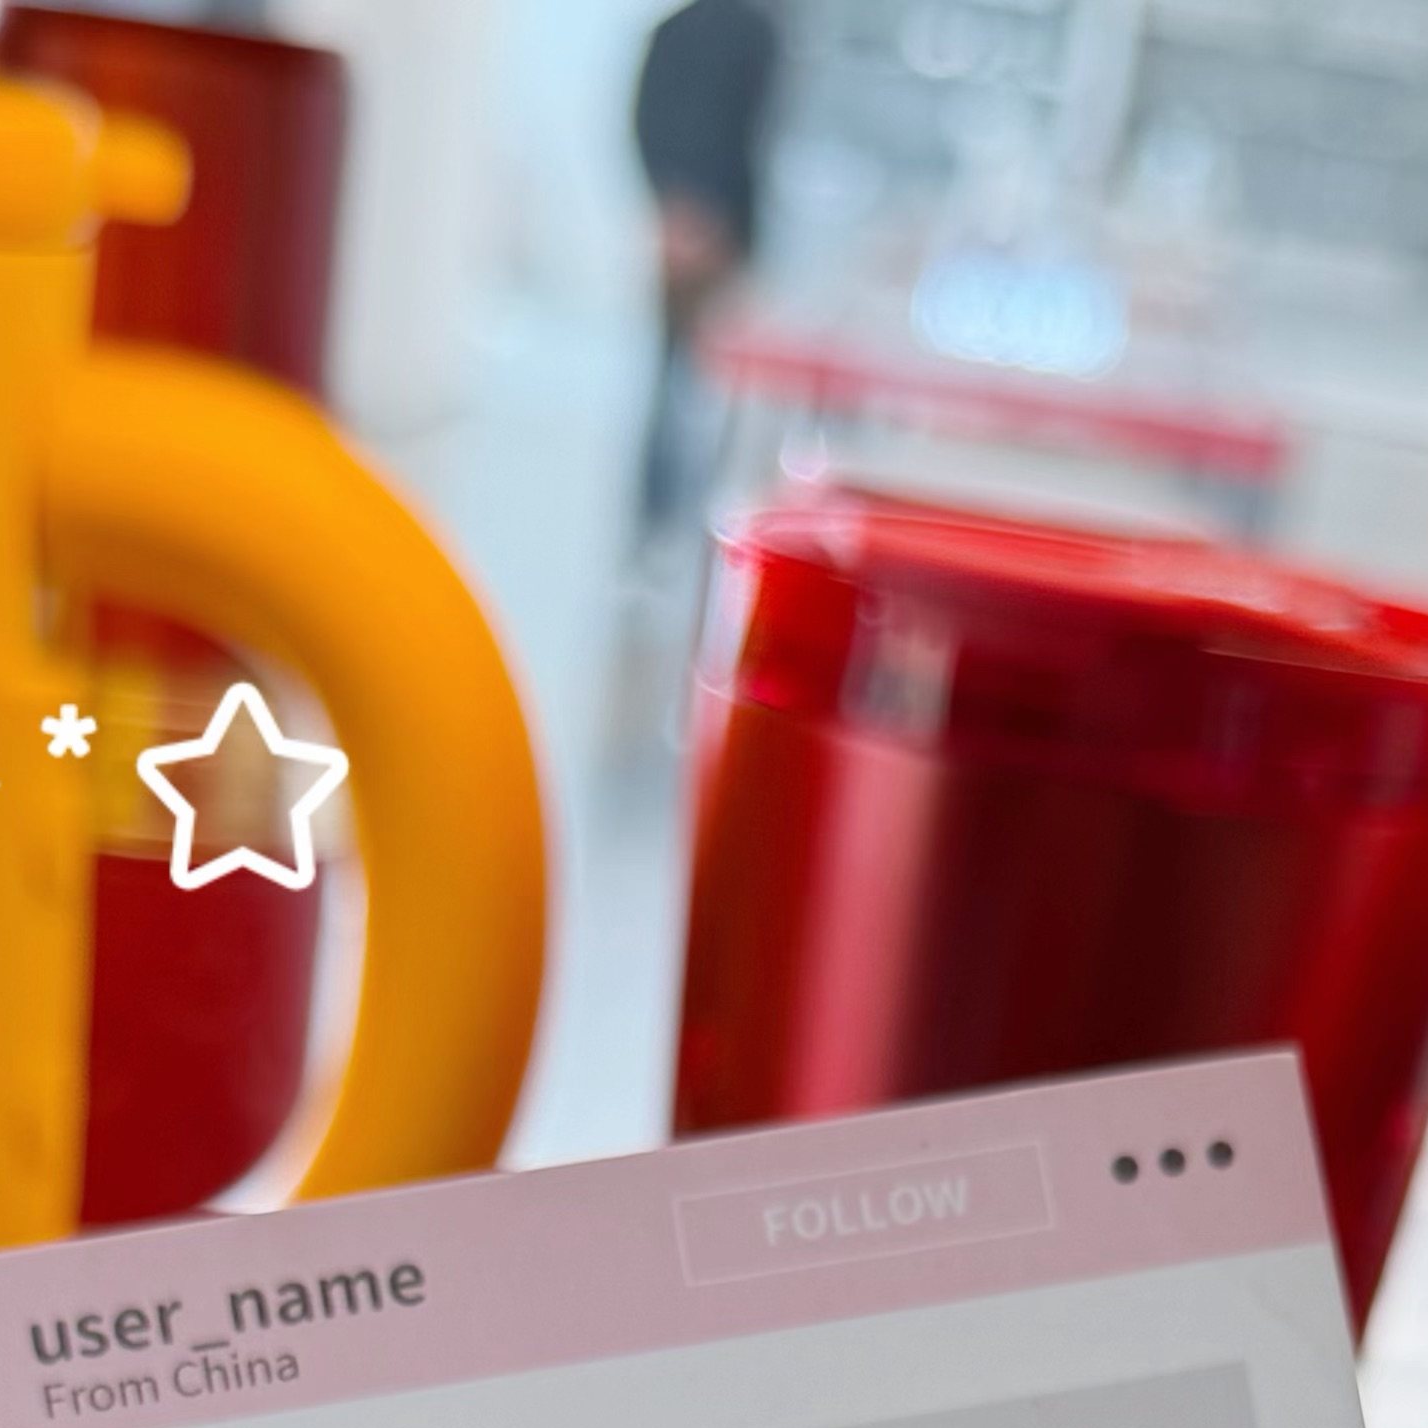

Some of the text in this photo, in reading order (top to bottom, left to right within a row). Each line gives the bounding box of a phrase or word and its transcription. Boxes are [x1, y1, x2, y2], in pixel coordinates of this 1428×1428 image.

[762, 1176, 970, 1248] FOLLOW
[28, 1260, 427, 1365] user_name
[42, 1347, 301, 1420] From China
